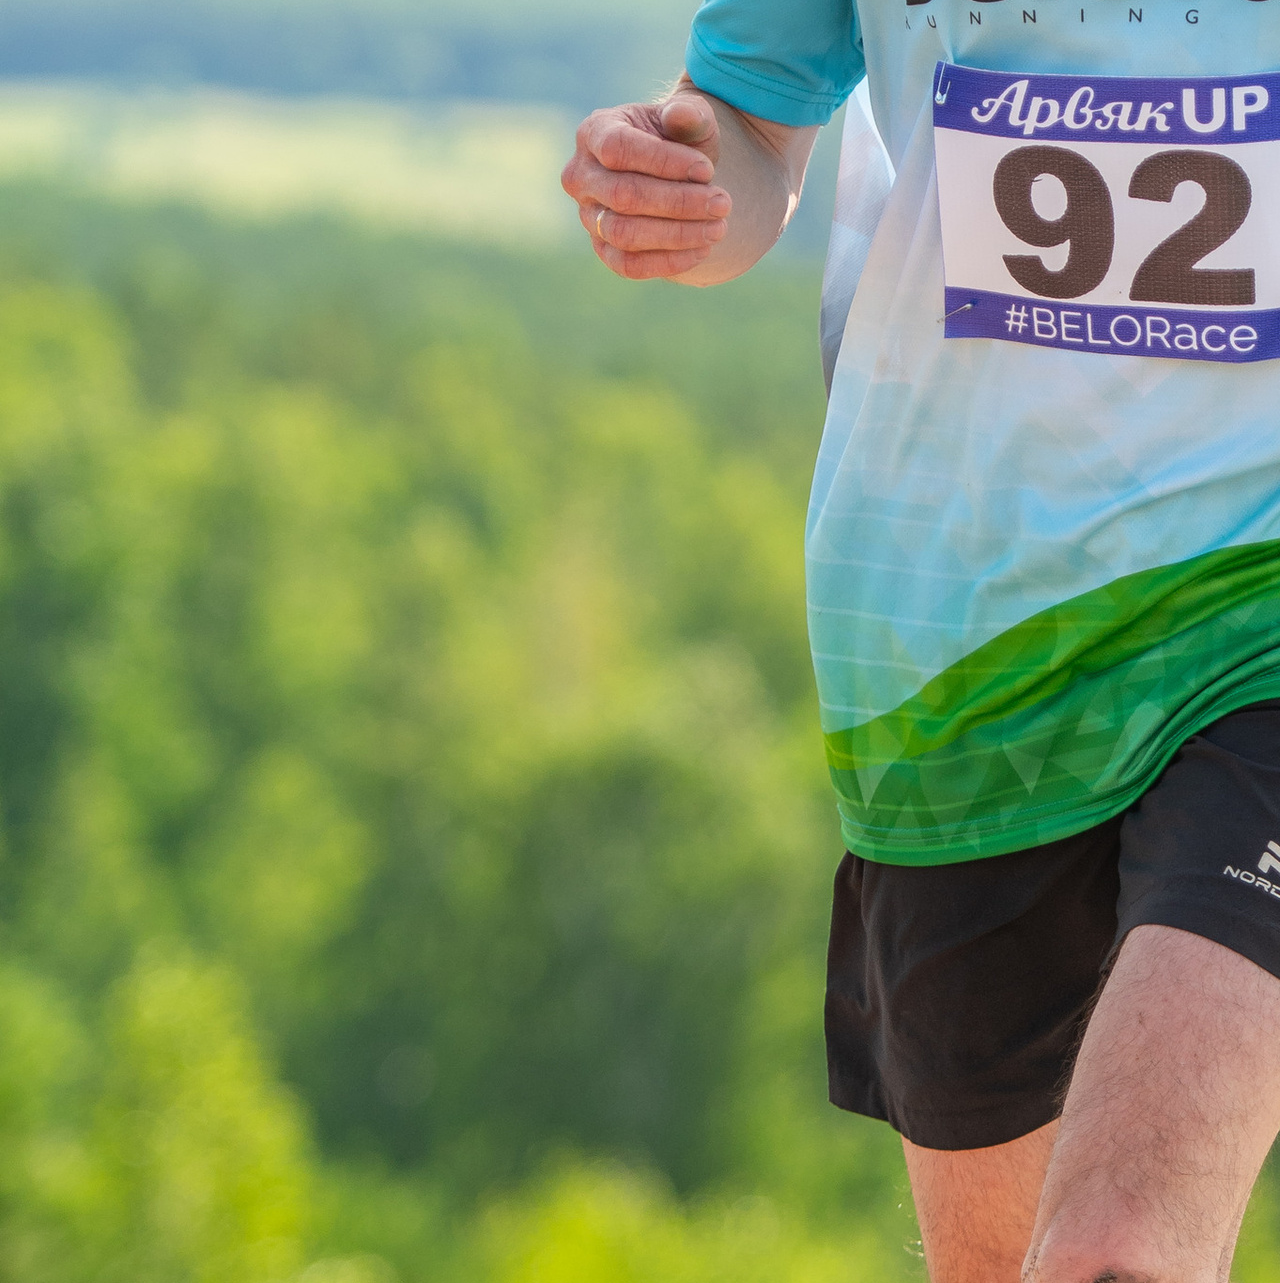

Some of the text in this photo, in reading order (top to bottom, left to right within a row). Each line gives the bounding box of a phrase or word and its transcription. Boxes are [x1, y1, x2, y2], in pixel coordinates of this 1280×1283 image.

[971, 79, 1269, 135] Арвяк UP
[993, 145, 1256, 306] 92
[1005, 305, 1258, 352] #BELORace
